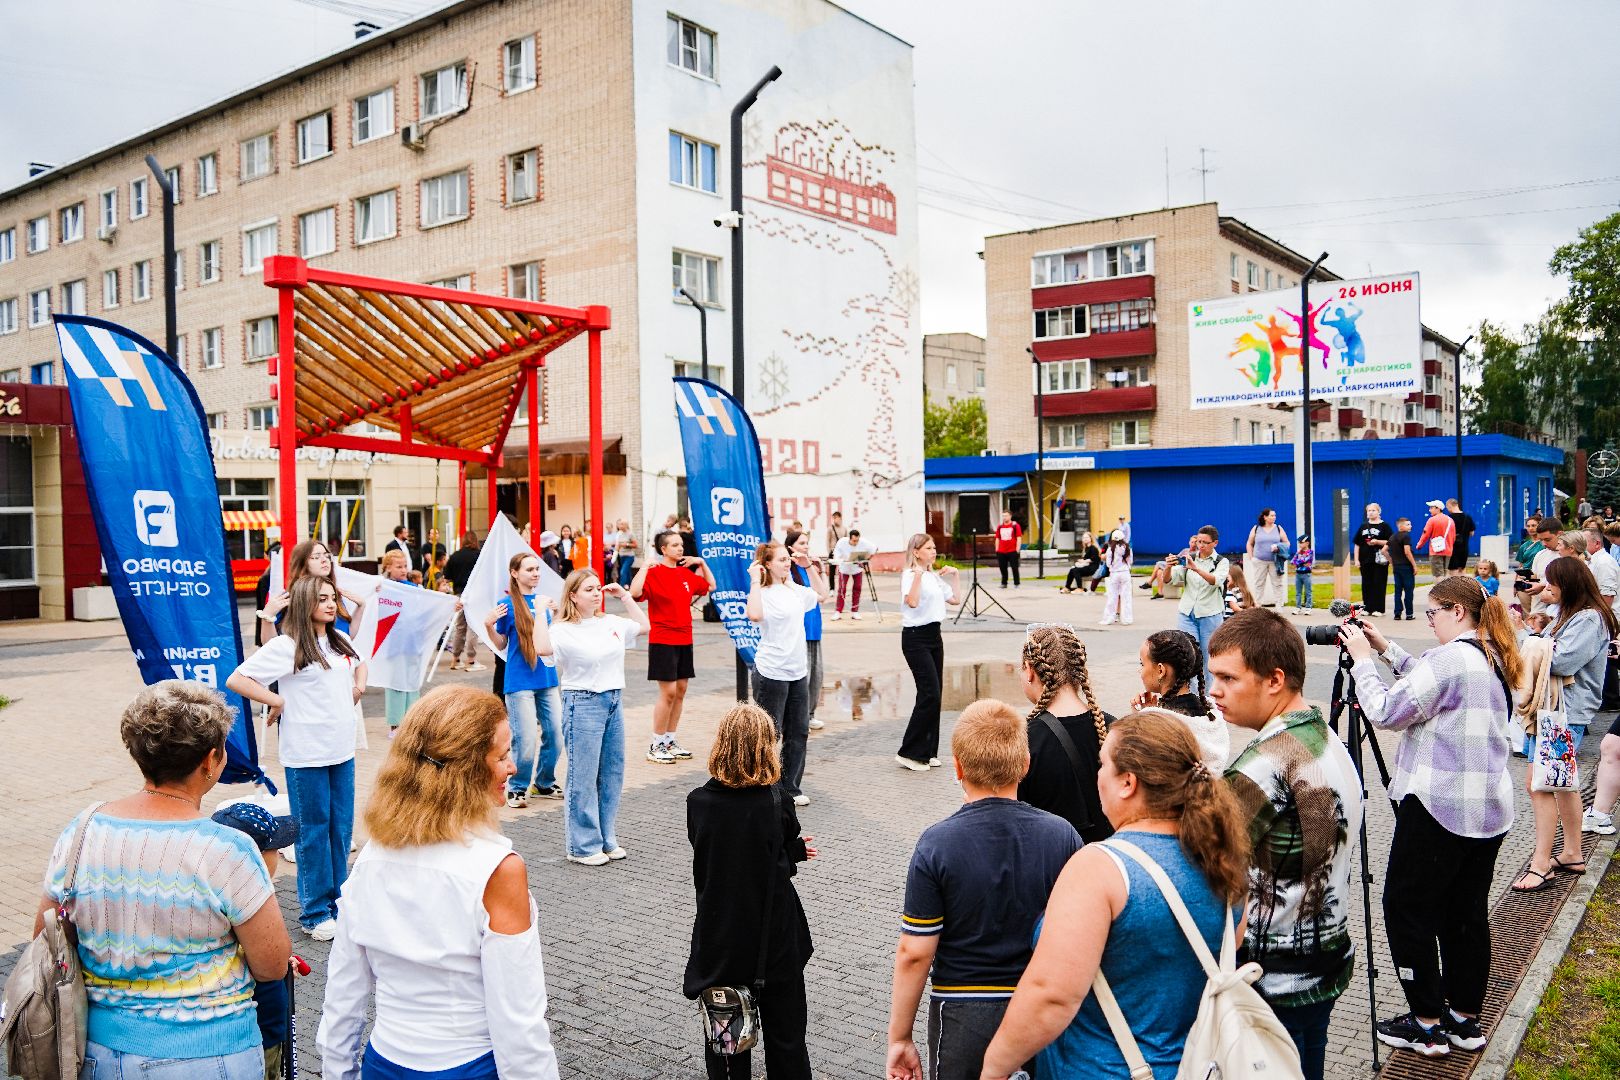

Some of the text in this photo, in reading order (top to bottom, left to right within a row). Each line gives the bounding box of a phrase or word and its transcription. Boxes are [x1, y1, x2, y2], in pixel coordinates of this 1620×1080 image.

[1339, 279, 1412, 299] 26 ИЮНЯ
[1219, 314, 1264, 325] СВОБОДНО
[1353, 362, 1412, 374] НАРКОТИКОВ
[1196, 391, 1272, 404] МЕЖДУНАРОДНЫЙ
[1274, 389, 1296, 398] ДЕНЬ
[1298, 386, 1335, 396] БРЬБЫ
[1345, 379, 1414, 391] НАРКОМАНИЕЙ
